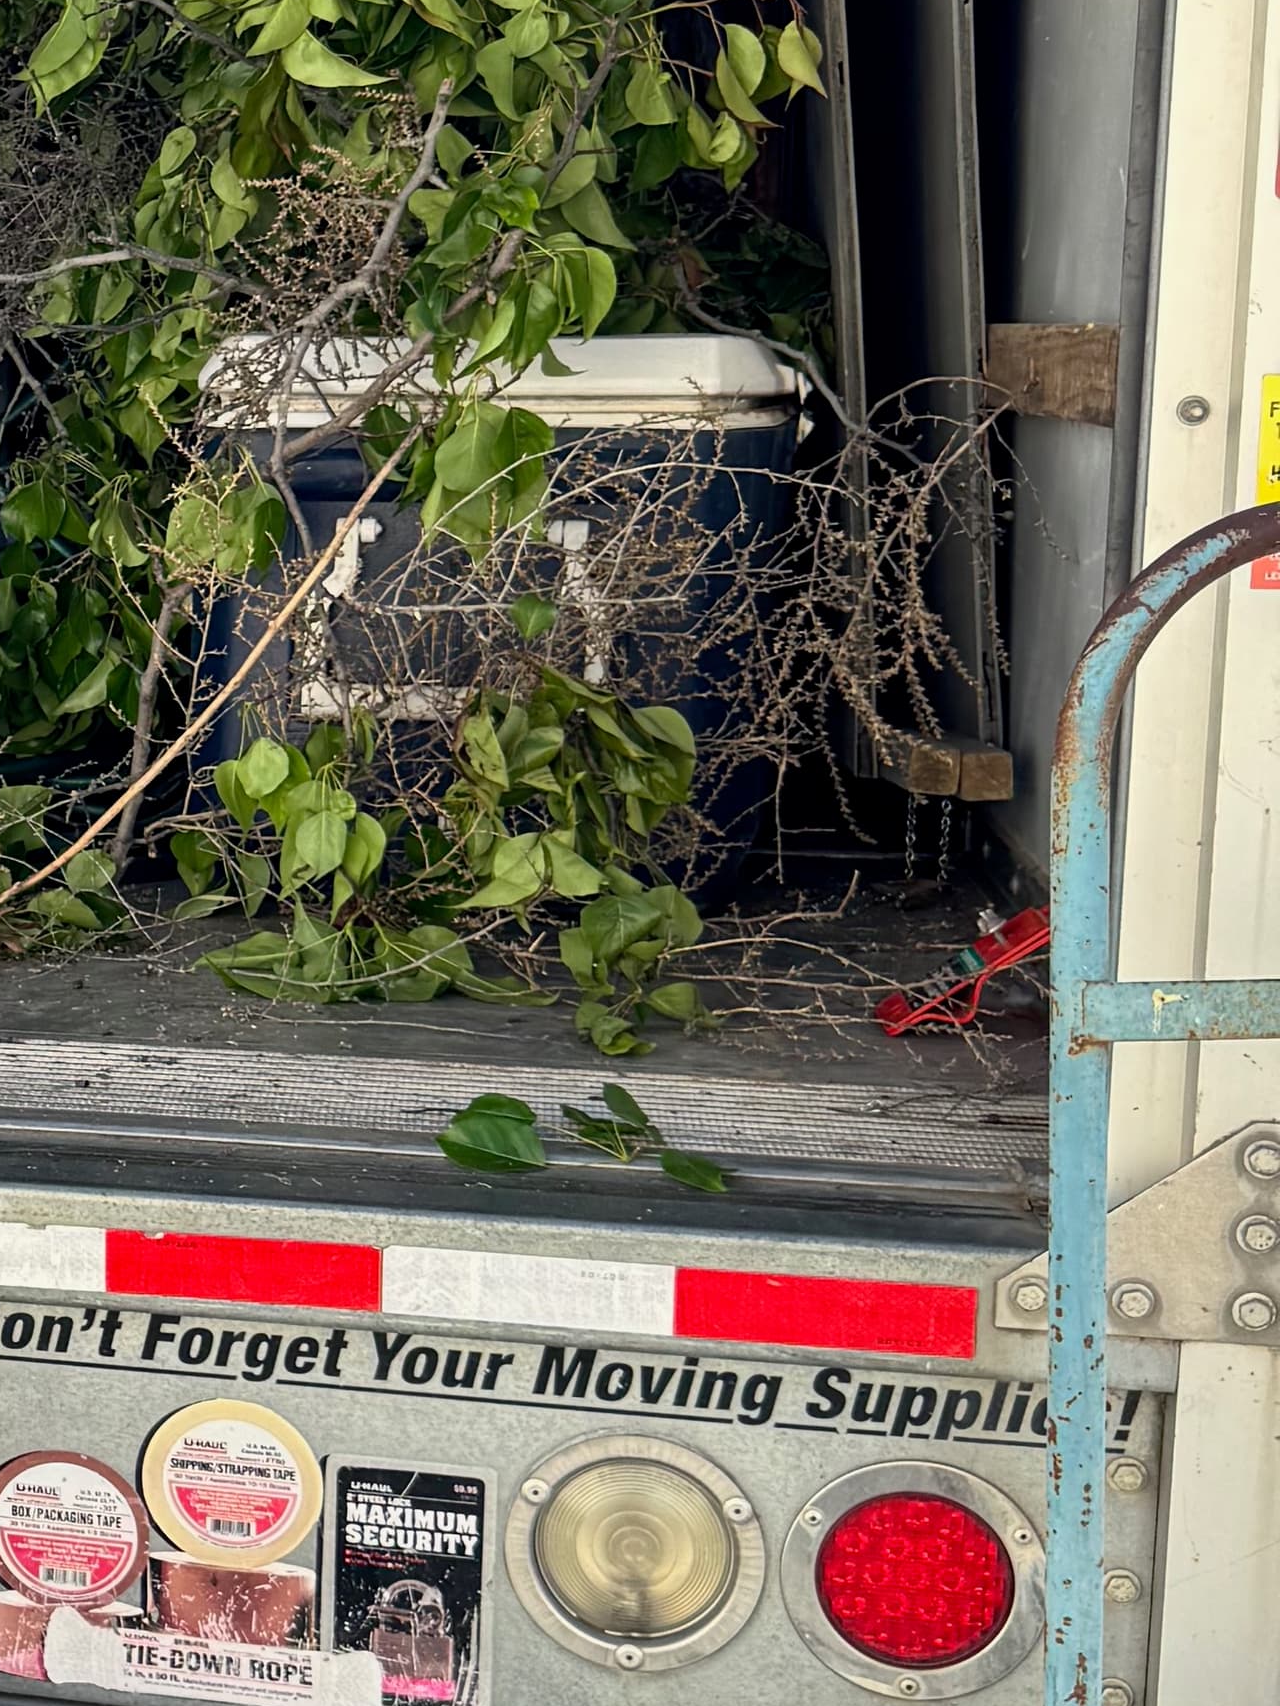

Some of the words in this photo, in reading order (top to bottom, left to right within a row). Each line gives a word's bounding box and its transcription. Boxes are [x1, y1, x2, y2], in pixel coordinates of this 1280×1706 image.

[139, 1313, 350, 1382] Forget
[371, 1329, 515, 1392] Your
[534, 1345, 785, 1429] Moving
[170, 1457, 271, 1479] SHIPPING/STRAPPING
[273, 1469, 296, 1481] TAPE
[351, 1481, 392, 1492] U-HAUL
[11, 1505, 94, 1525] BOX/PACKAGING
[97, 1515, 122, 1529] TAPE
[346, 1502, 479, 1535] MAXIMUM
[345, 1524, 478, 1556] SECURITY
[123, 1643, 241, 1677] TIE-DOWN
[249, 1659, 313, 1686] ROPE
